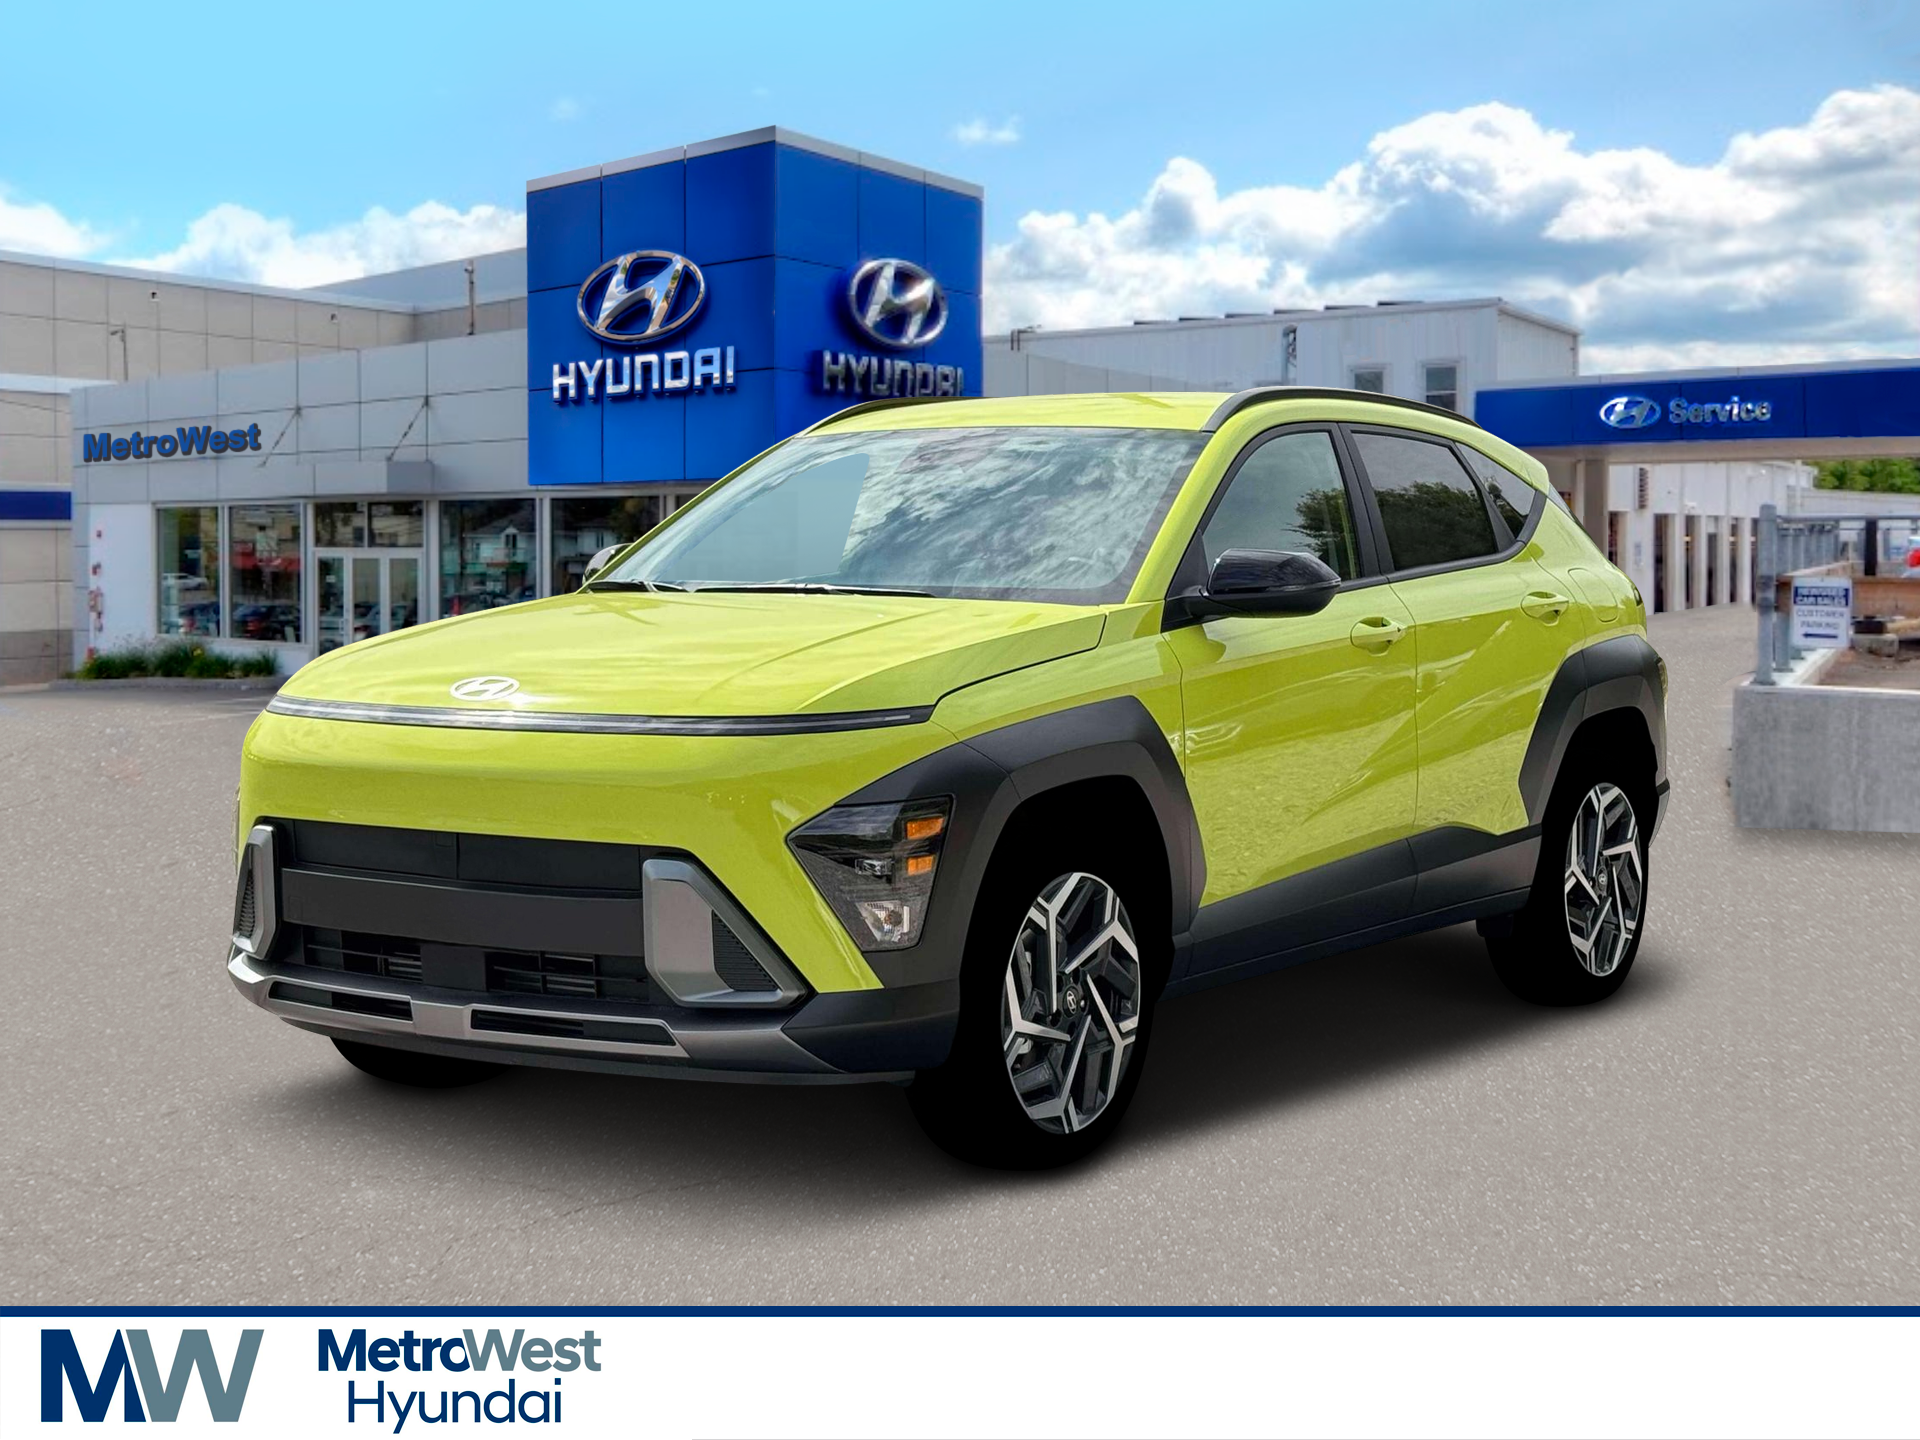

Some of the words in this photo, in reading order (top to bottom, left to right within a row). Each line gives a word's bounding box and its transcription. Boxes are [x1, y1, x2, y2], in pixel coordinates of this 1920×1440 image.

[552, 345, 736, 399] HYUNDAI
[822, 350, 965, 397] HYUNDAI
[1668, 395, 1772, 424] Service
[83, 423, 261, 462] MetroWest
[1796, 608, 1845, 618] CUSTOMER
[1800, 620, 1840, 630] PARKING
